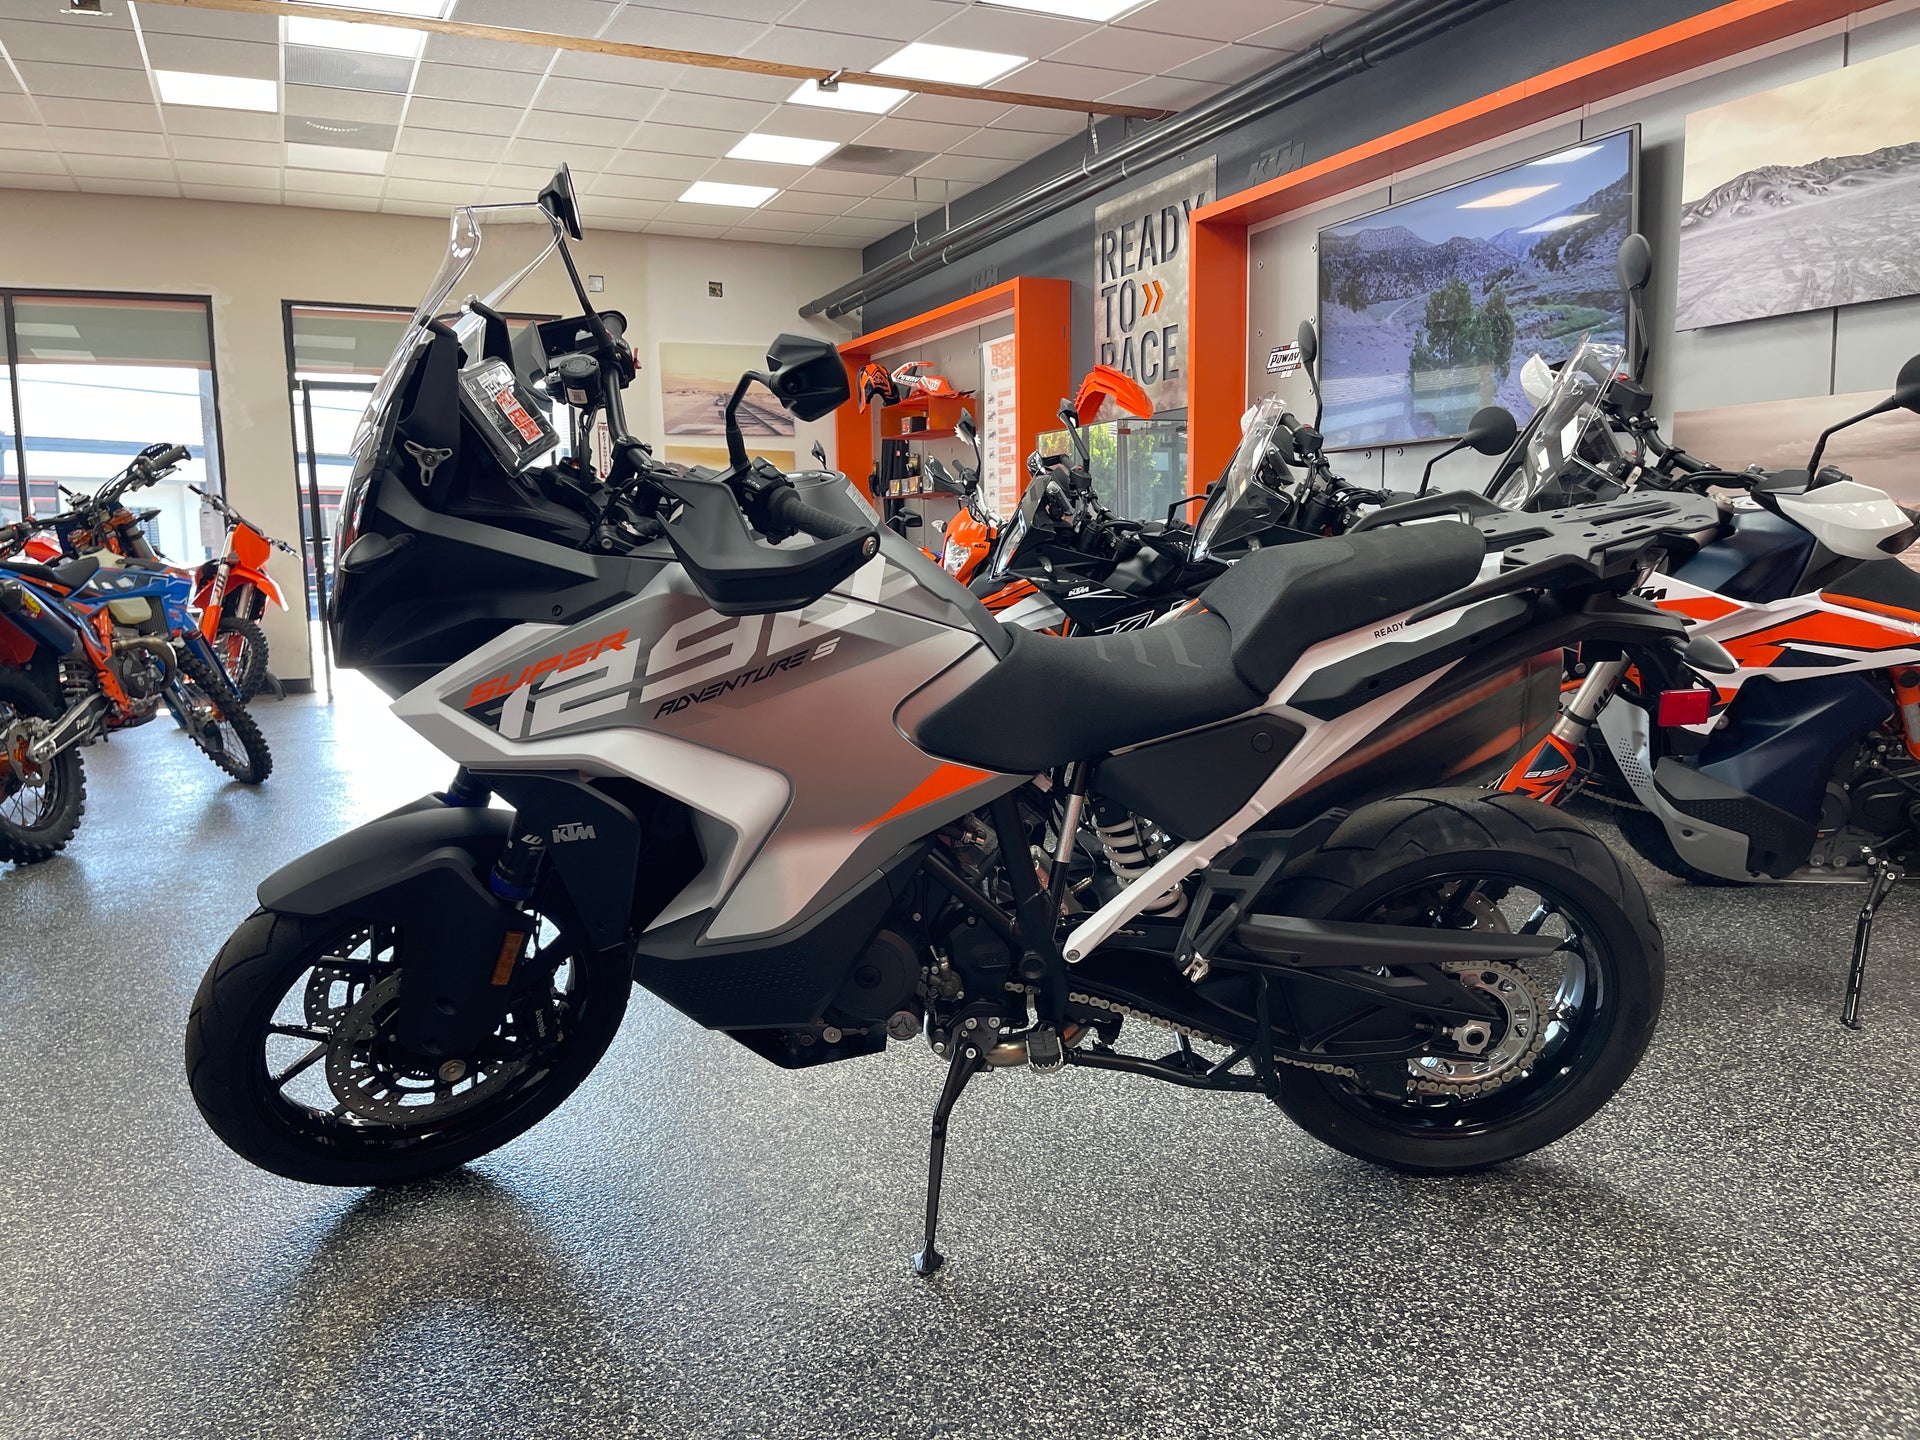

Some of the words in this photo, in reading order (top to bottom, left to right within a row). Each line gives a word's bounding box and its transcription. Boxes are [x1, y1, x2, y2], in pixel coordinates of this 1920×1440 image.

[1248, 138, 1305, 186] KTM
[1101, 278, 1137, 339] TO
[1270, 352, 1300, 366] POWAY
[1068, 586, 1090, 597] KTM
[1632, 586, 1668, 600] TM
[1373, 621, 1405, 640] READY
[464, 628, 631, 709] SUPER
[653, 652, 805, 720] ADVENTURE
[810, 636, 842, 662] S
[551, 821, 597, 844] KTM
[535, 1008, 547, 1038] brembo
